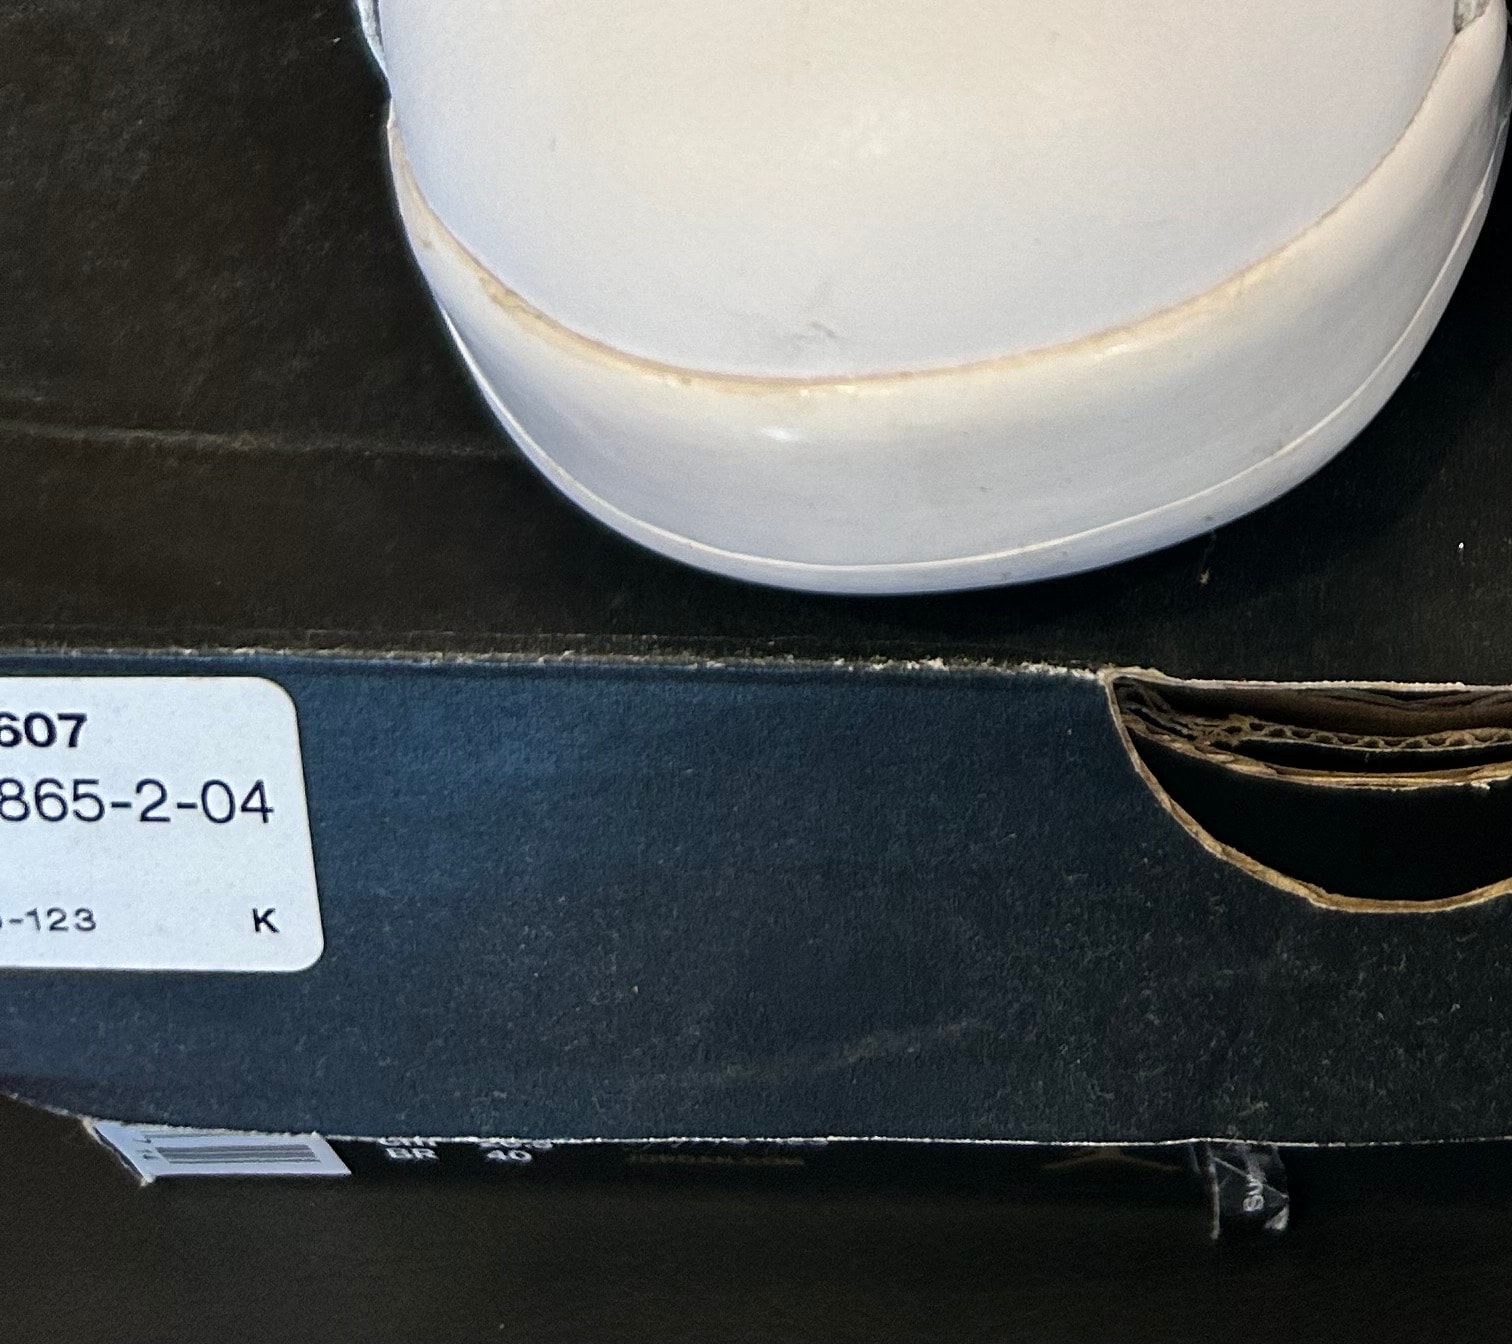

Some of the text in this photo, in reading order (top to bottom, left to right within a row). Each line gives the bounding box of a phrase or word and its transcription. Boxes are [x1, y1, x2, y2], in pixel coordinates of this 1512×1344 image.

[0, 712, 88, 748] 607
[0, 777, 275, 823] 865-2-04
[252, 907, 280, 933] K
